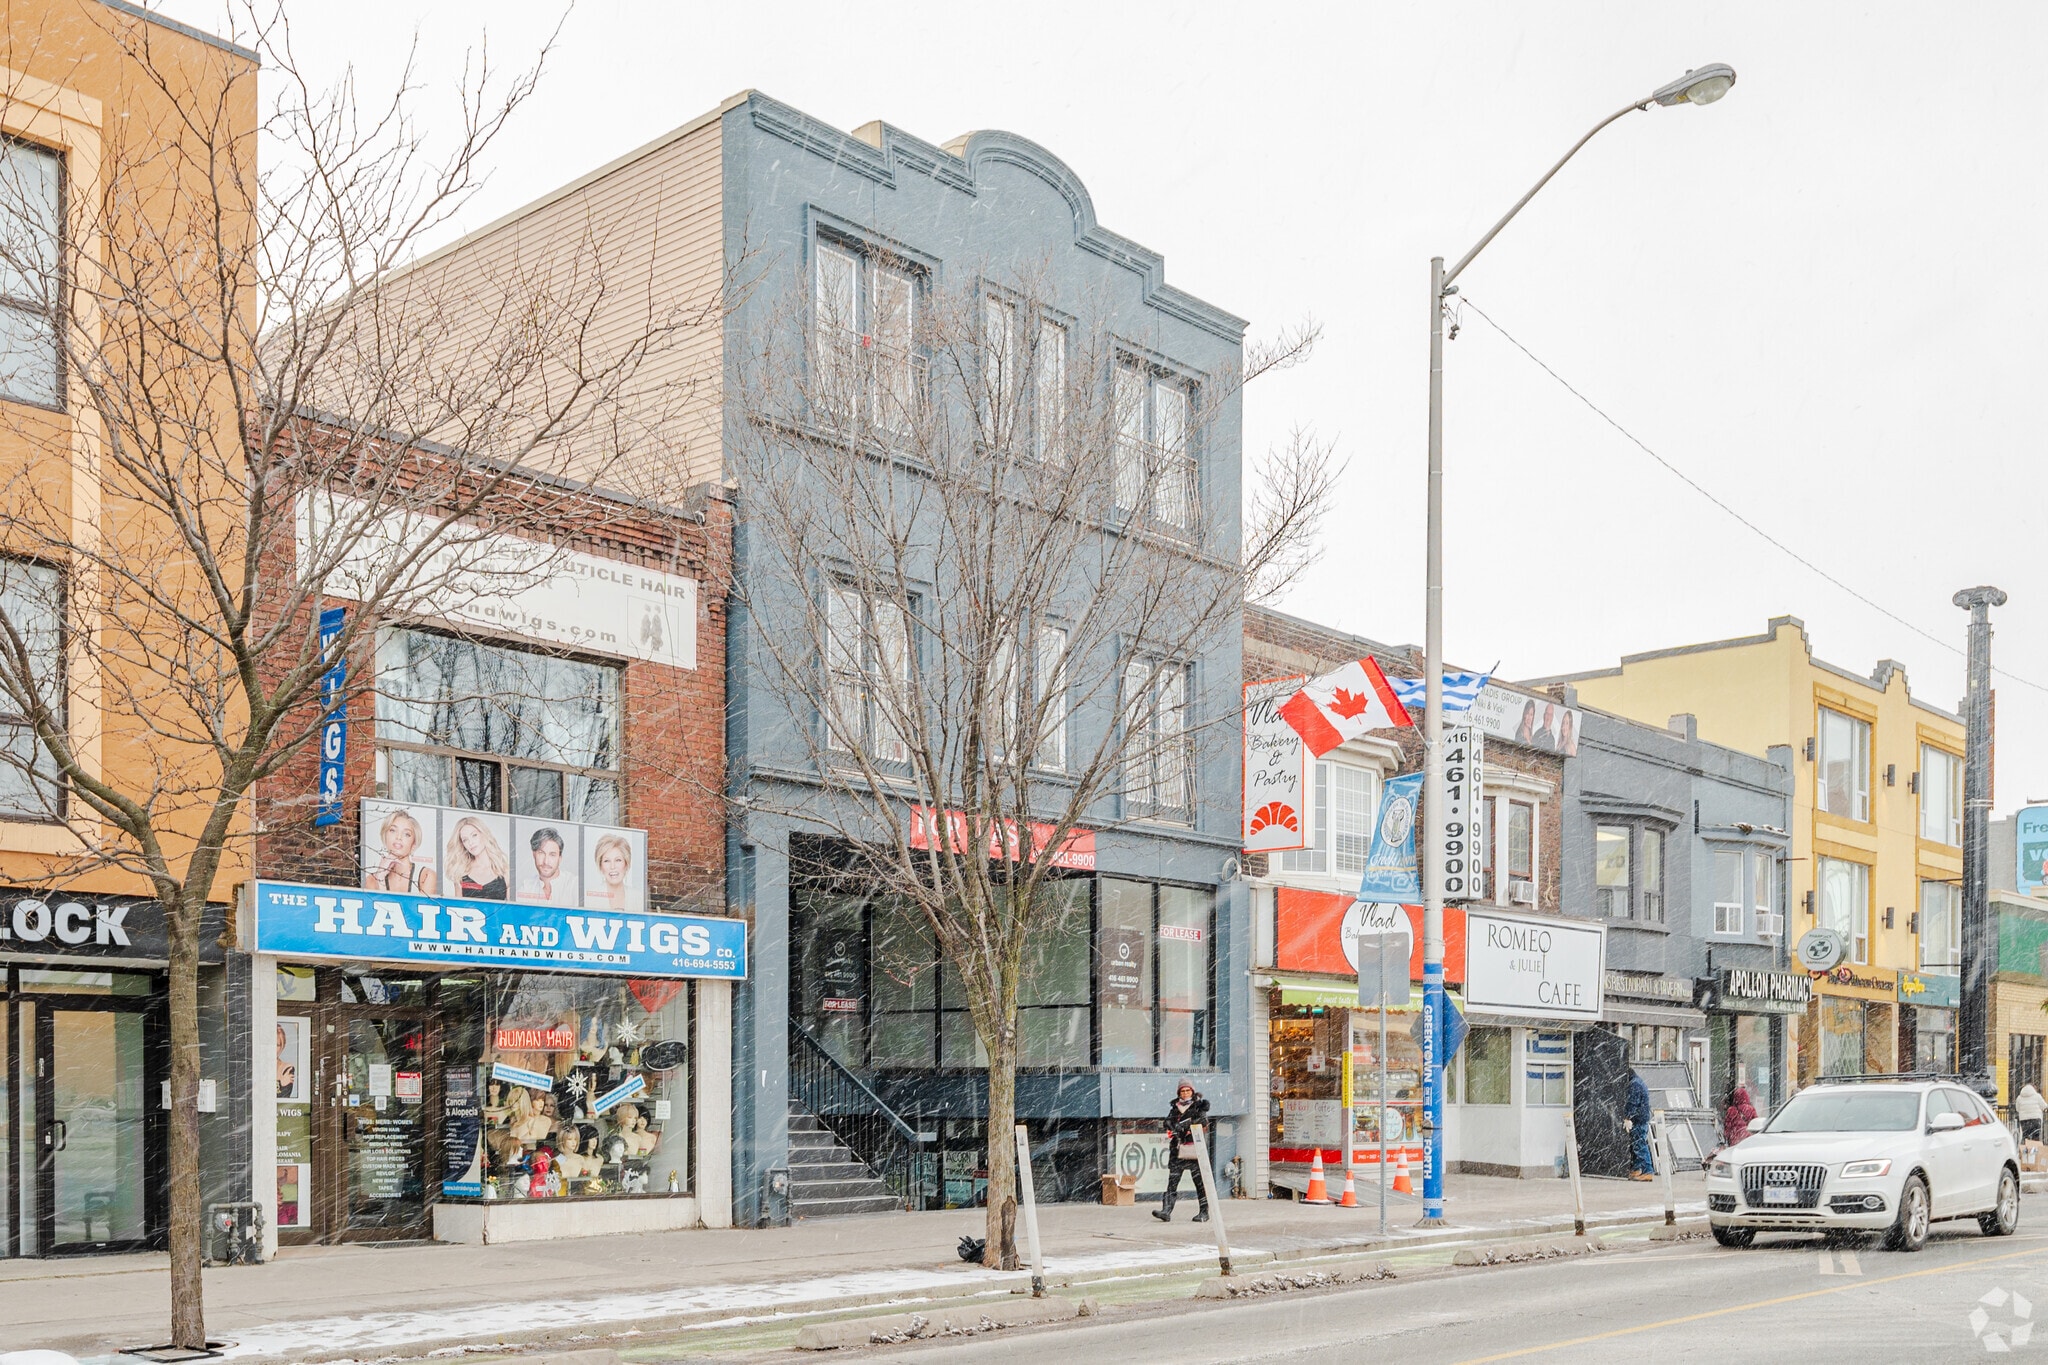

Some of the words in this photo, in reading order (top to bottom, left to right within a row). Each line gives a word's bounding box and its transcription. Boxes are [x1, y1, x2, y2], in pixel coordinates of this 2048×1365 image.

[640, 577, 686, 599] HAIR
[1501, 692, 1523, 705] GROUP
[1250, 698, 1287, 726] Vla
[1250, 733, 1299, 755] Bakery
[1253, 769, 1298, 793] Pastry
[0, 900, 131, 946] OCK
[269, 893, 308, 906] THE
[314, 895, 488, 943] HAIR
[499, 923, 559, 947] AND
[565, 915, 711, 957] WIGS
[716, 948, 736, 959] CO.
[1360, 902, 1398, 929] Vlad
[1160, 927, 1174, 938] FOR
[1176, 929, 1200, 940] LEASE
[1488, 923, 1552, 953] ROMEO
[413, 942, 628, 964] WWW.HAIRANDWIGS.COM
[672, 958, 736, 971] 416-694-5553
[1509, 959, 1516, 970] &
[1108, 974, 1117, 982] 416
[1118, 975, 1126, 983] 461
[1126, 976, 1139, 984] 9900
[1611, 974, 1652, 993] RESTAURANT
[1730, 969, 1768, 998] APOLLON
[1770, 973, 1814, 1002] PHARMACY
[1538, 981, 1582, 1006] CAFE
[499, 1030, 541, 1047] HUMAN
[546, 1030, 573, 1047] HAIR
[1423, 1005, 1433, 1083] GREEKTOWN
[280, 1108, 302, 1117] WIGS
[445, 1098, 467, 1107] Cancer
[451, 1106, 479, 1118] Alopecia
[1423, 1111, 1433, 1180] DFORTH
